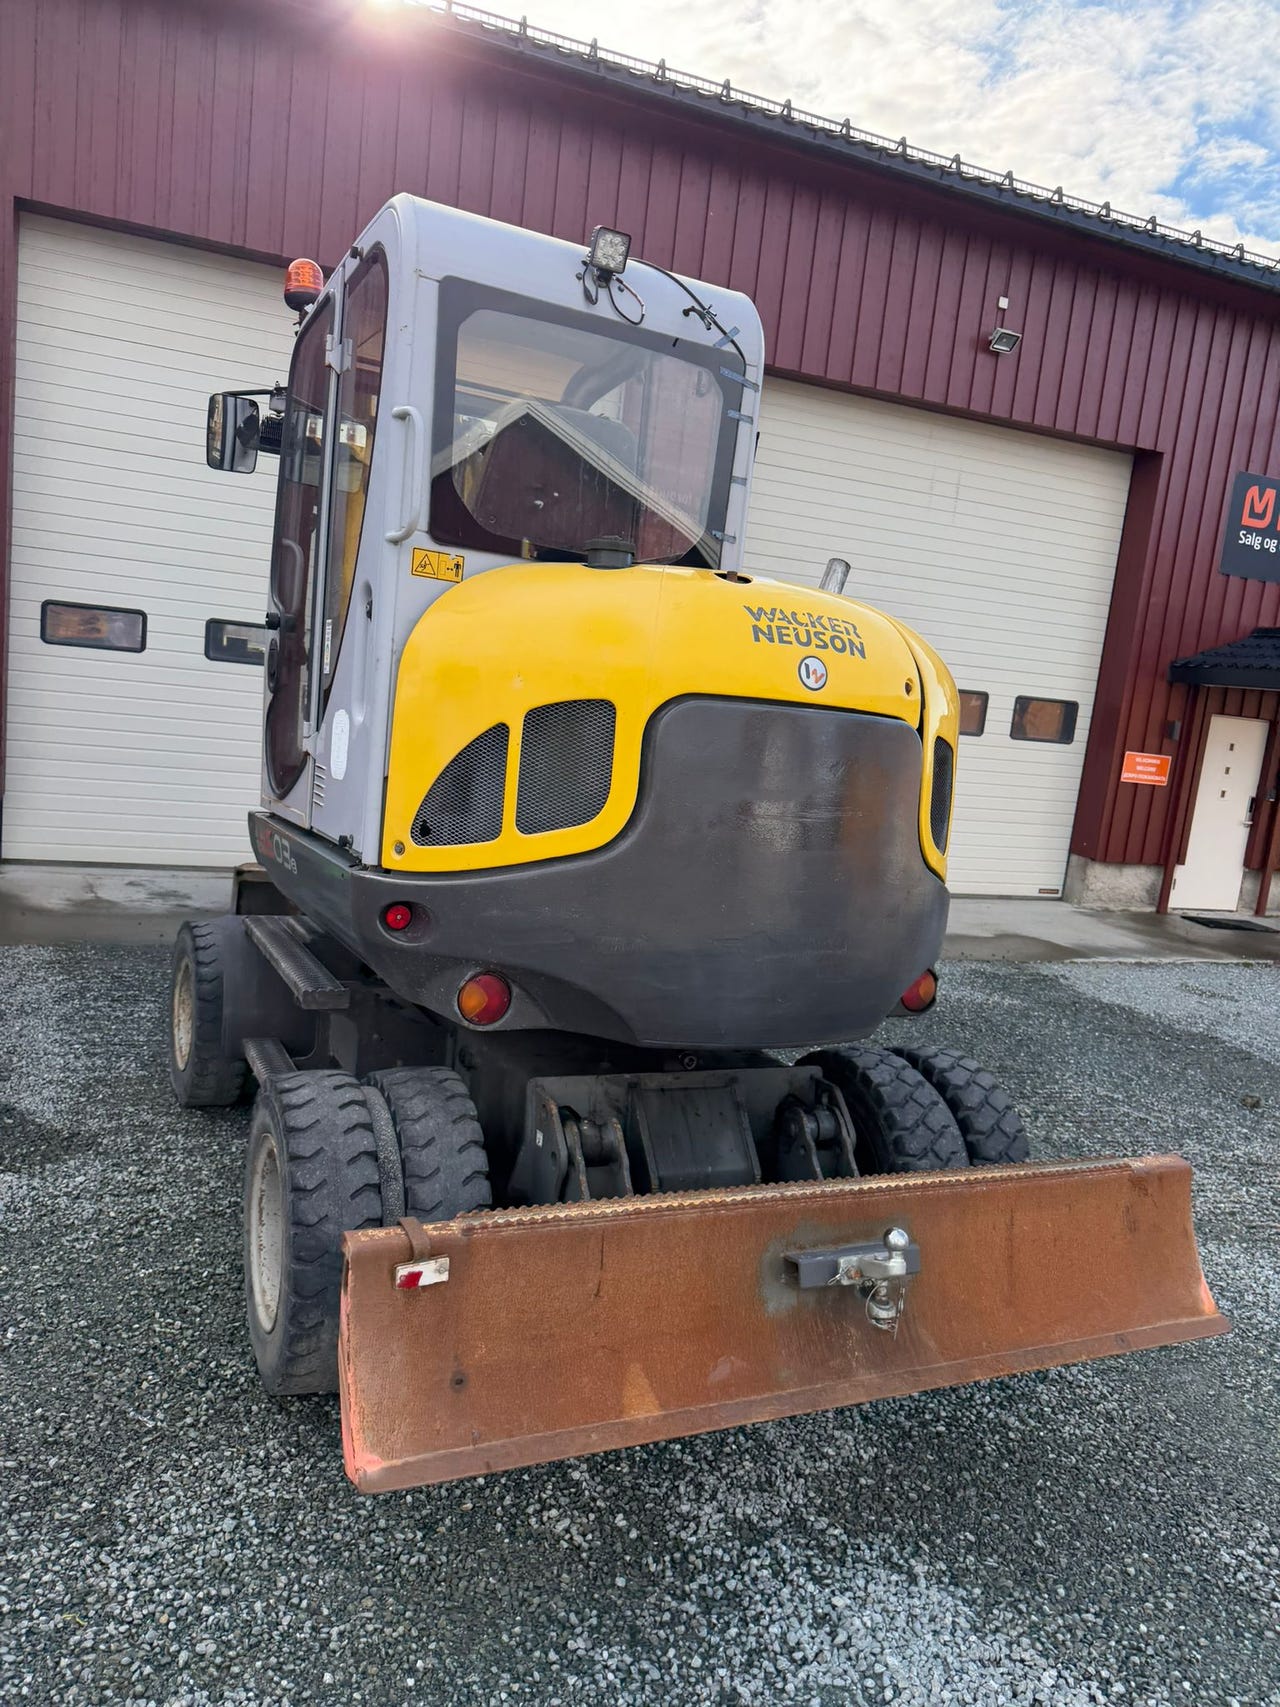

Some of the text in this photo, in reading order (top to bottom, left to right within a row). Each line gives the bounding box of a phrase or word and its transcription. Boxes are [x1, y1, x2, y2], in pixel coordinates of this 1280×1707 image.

[1239, 530, 1278, 553] Salg og
[743, 605, 862, 639] WACKER
[752, 624, 866, 659] NEUSON
